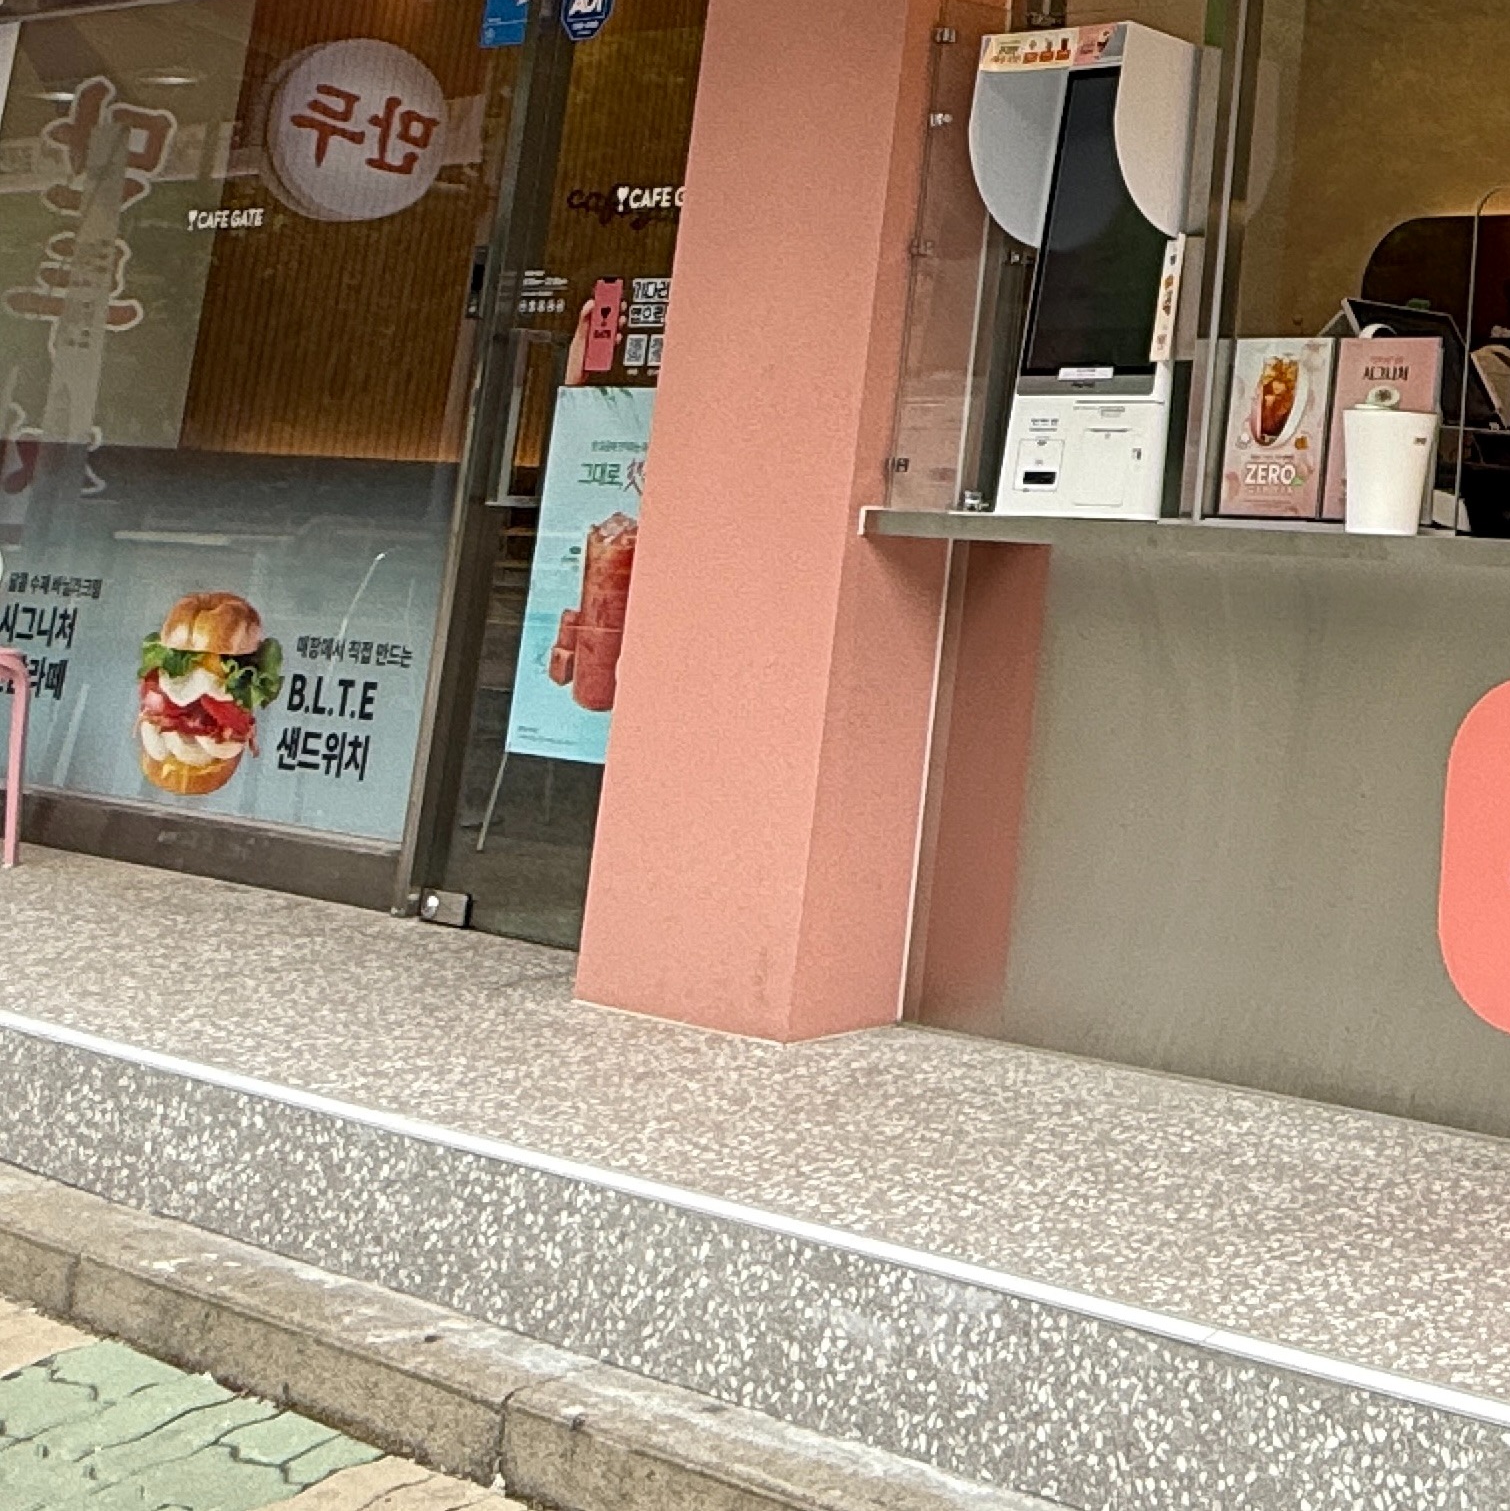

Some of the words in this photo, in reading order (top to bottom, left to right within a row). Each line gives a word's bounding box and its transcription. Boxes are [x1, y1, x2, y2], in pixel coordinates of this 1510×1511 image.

[629, 187, 673, 209] CAFE
[197, 210, 230, 229] CAFE
[230, 208, 264, 228] GATE
[1244, 463, 1296, 485] ZERO
[0, 601, 78, 649] 시그니처
[287, 673, 378, 721] B.L.T.E
[276, 726, 371, 782] 샌드위치
